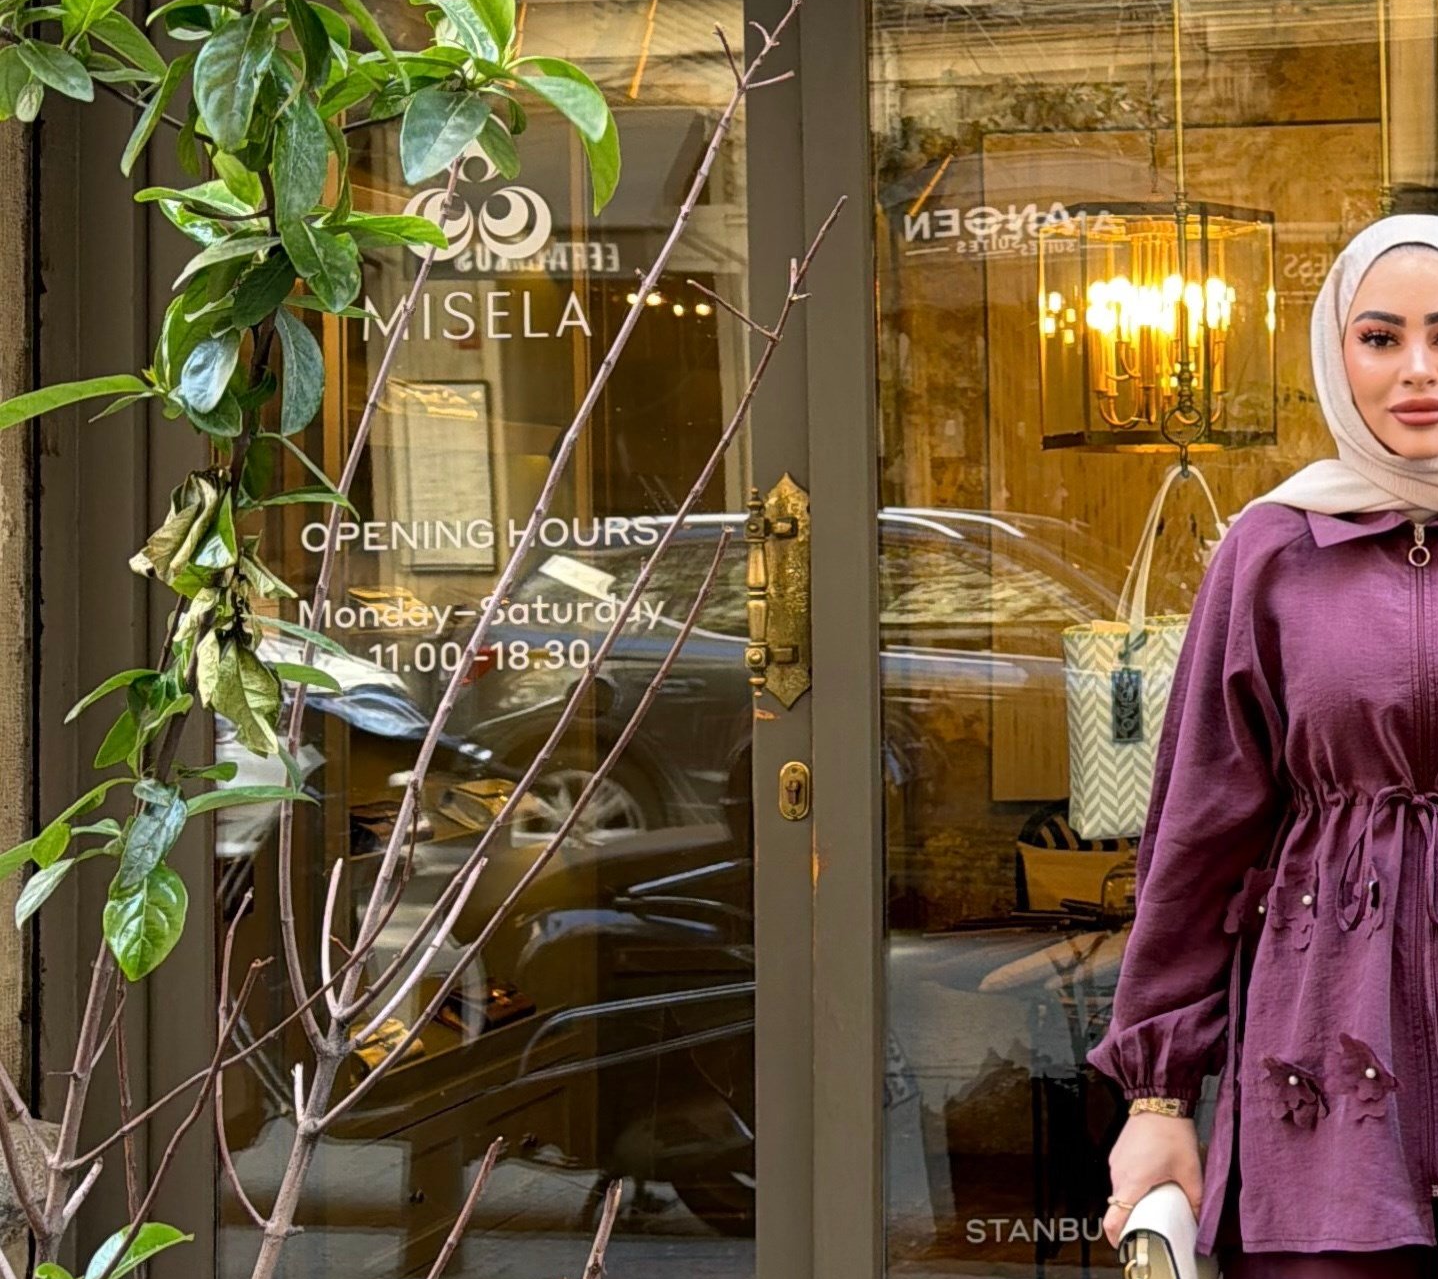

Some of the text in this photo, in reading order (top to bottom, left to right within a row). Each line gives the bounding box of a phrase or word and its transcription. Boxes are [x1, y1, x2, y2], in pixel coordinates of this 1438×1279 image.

[362, 289, 593, 342] MISELA
[301, 516, 660, 553] OPENING HOURS
[965, 1217, 1103, 1244] STANBU
